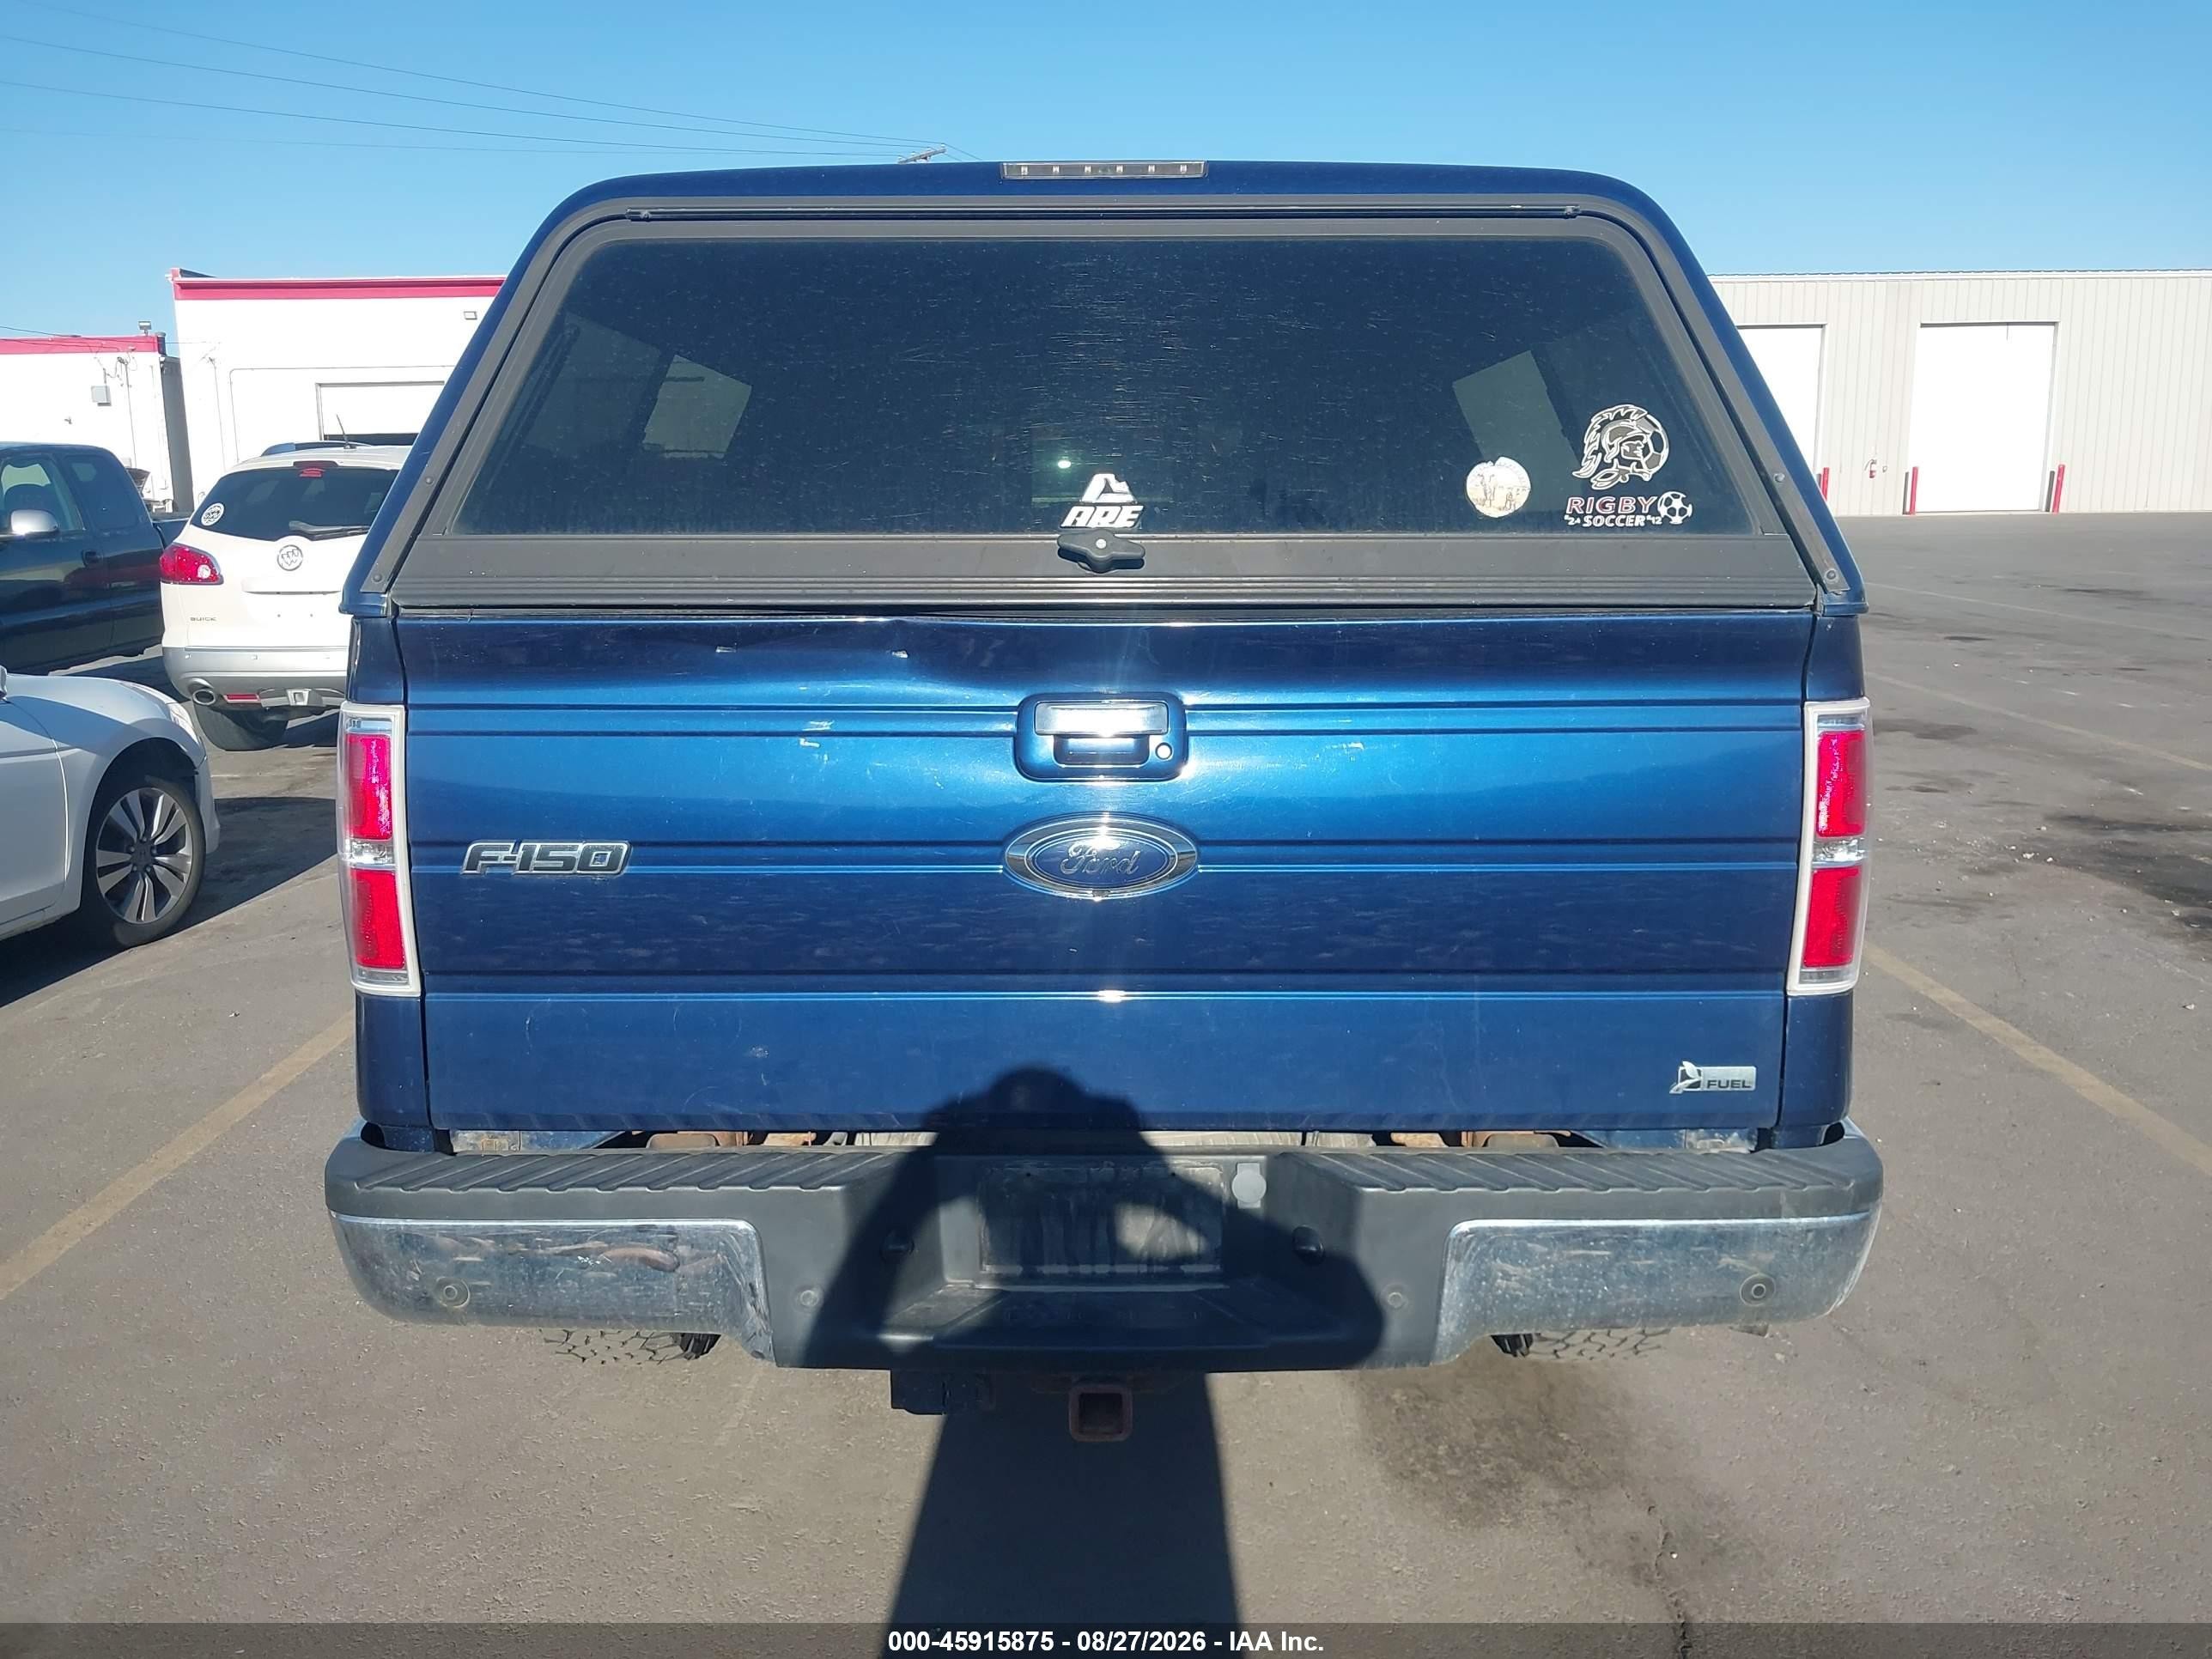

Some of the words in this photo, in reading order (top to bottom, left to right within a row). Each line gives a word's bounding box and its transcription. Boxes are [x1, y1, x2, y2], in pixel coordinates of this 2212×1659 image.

[1565, 495, 1658, 514] RIGBY
[1582, 514, 1646, 527] SOCCER
[460, 840, 633, 876] F-150
[1060, 838, 1142, 876] Ford
[1706, 1079, 1753, 1090] FUEL
